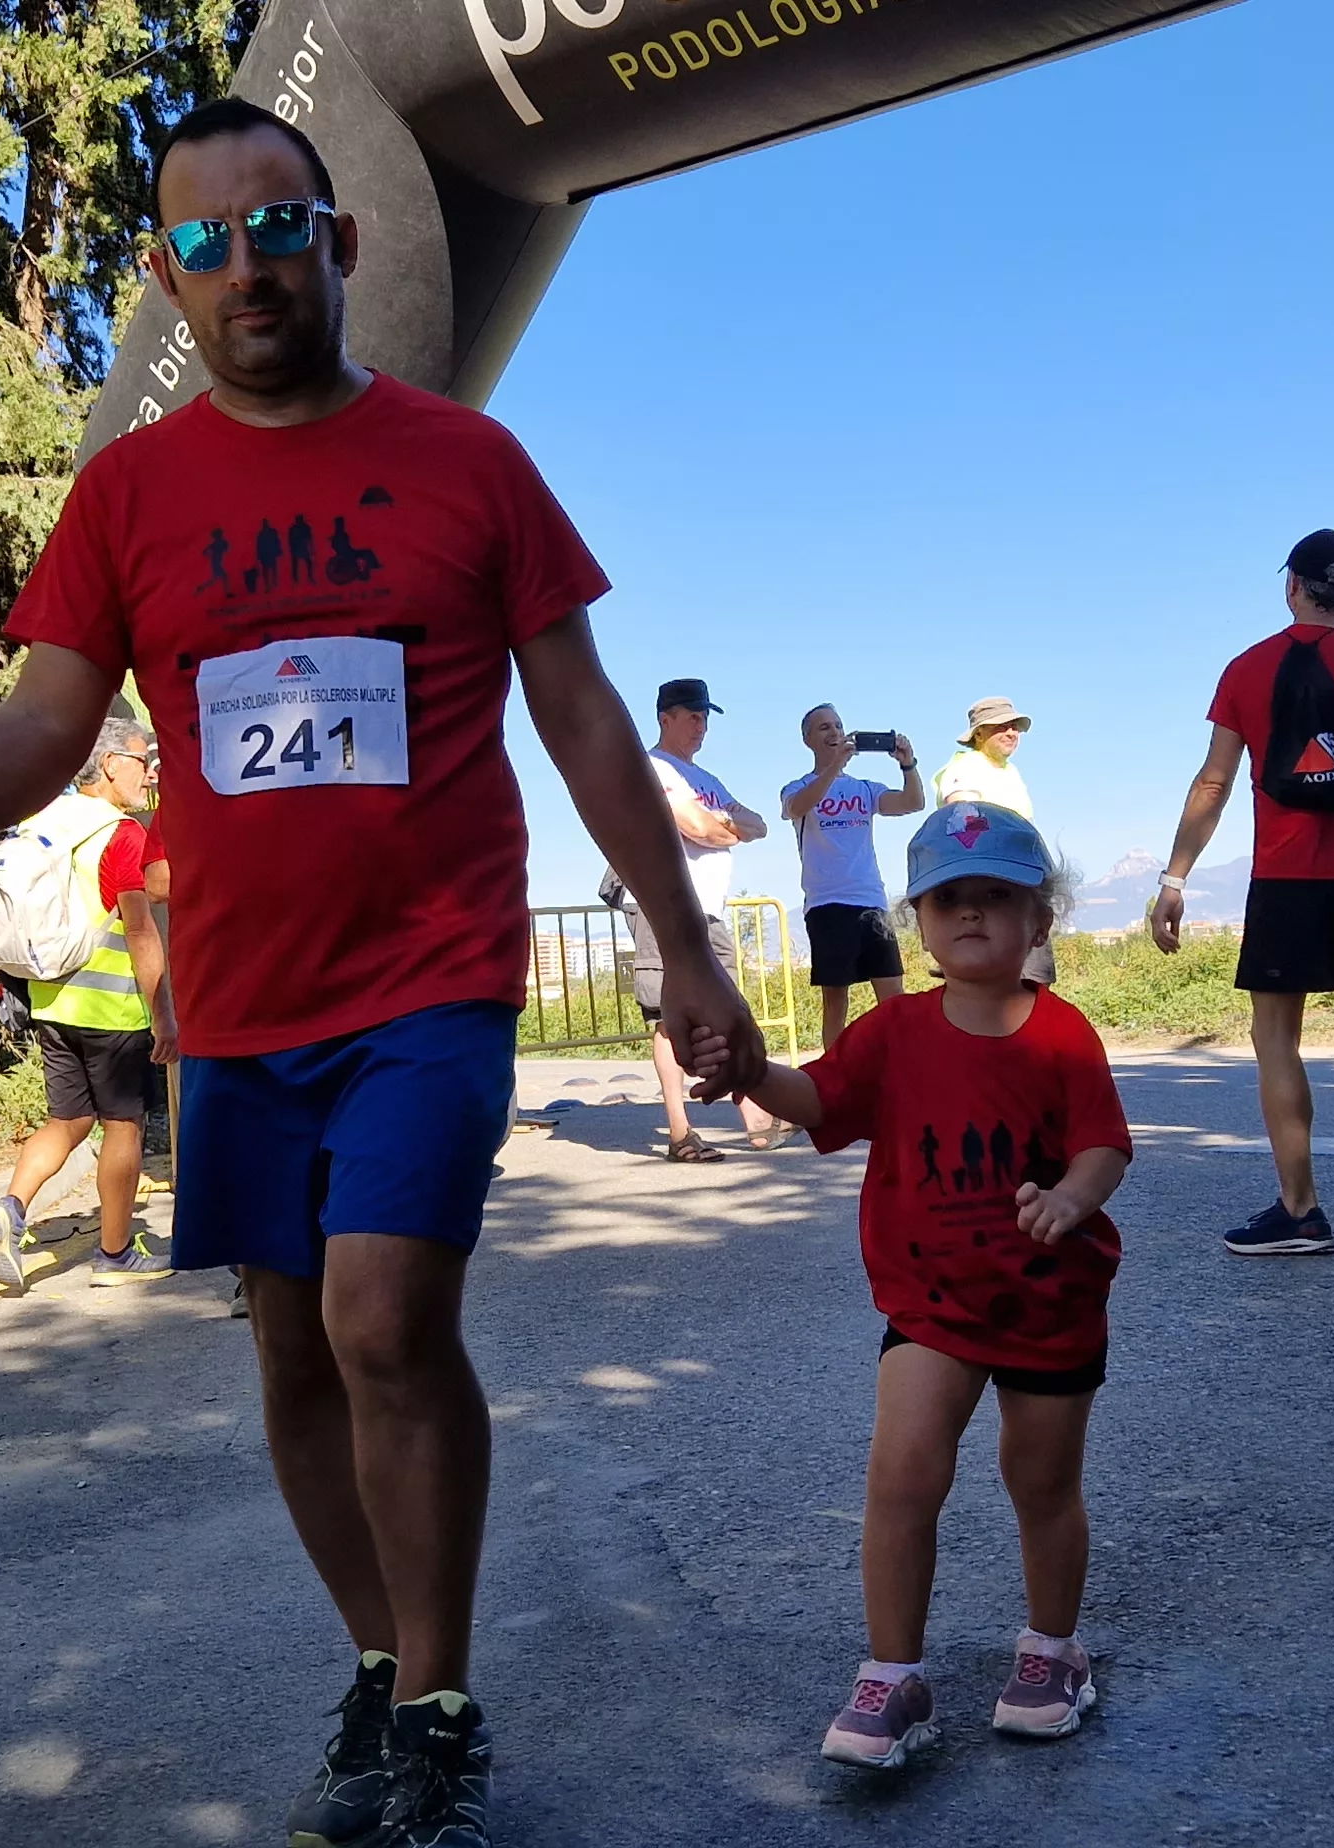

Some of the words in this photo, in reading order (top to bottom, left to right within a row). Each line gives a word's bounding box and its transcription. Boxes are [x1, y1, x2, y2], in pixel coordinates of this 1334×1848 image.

[274, 20, 324, 125] ejor
[210, 701, 240, 716] MARCHA
[242, 692, 280, 710] SOLIDARIA
[281, 691, 297, 705] POR
[299, 689, 310, 703] LA
[311, 688, 359, 703] ESCLEROSIS
[360, 684, 397, 703] MÚLTIPLE
[240, 716, 355, 780] 241
